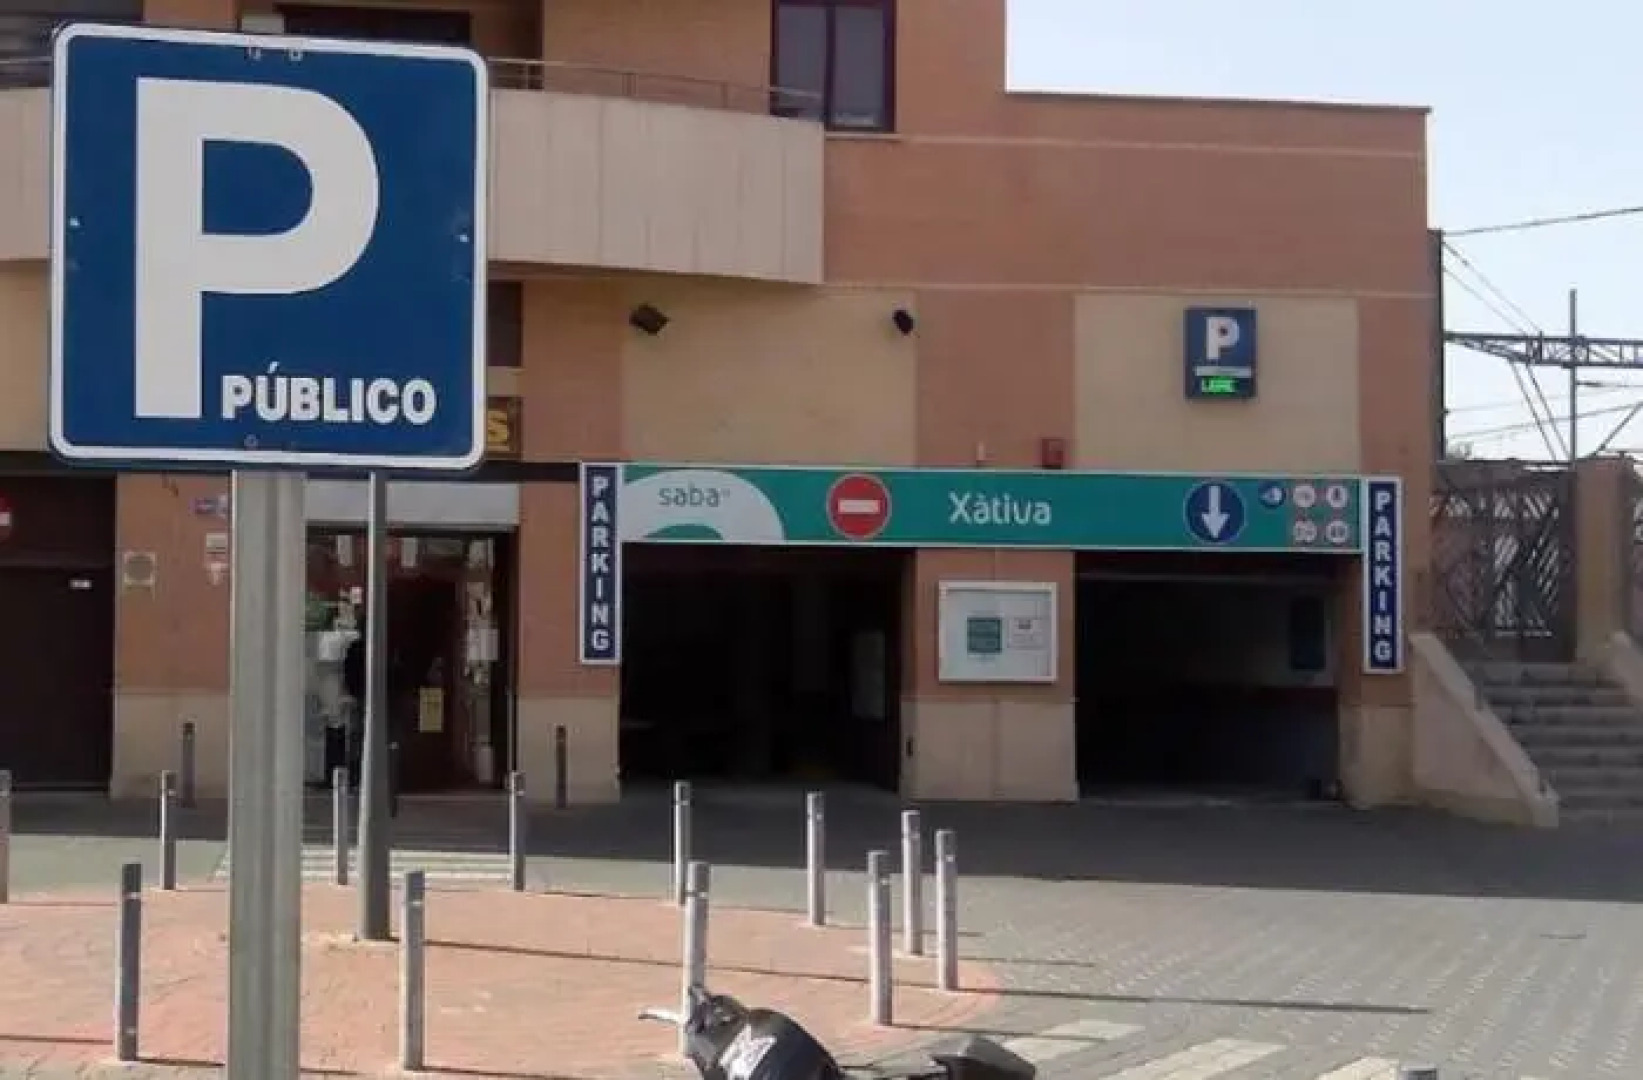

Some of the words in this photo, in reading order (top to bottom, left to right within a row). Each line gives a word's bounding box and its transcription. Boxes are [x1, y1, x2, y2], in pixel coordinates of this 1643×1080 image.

[136, 77, 379, 418] P
[221, 361, 437, 425] PÚBLICO
[1206, 316, 1239, 360] P
[591, 476, 610, 651] PARKING
[949, 491, 1052, 525] Xàtiva
[1374, 490, 1392, 662] PARKING
